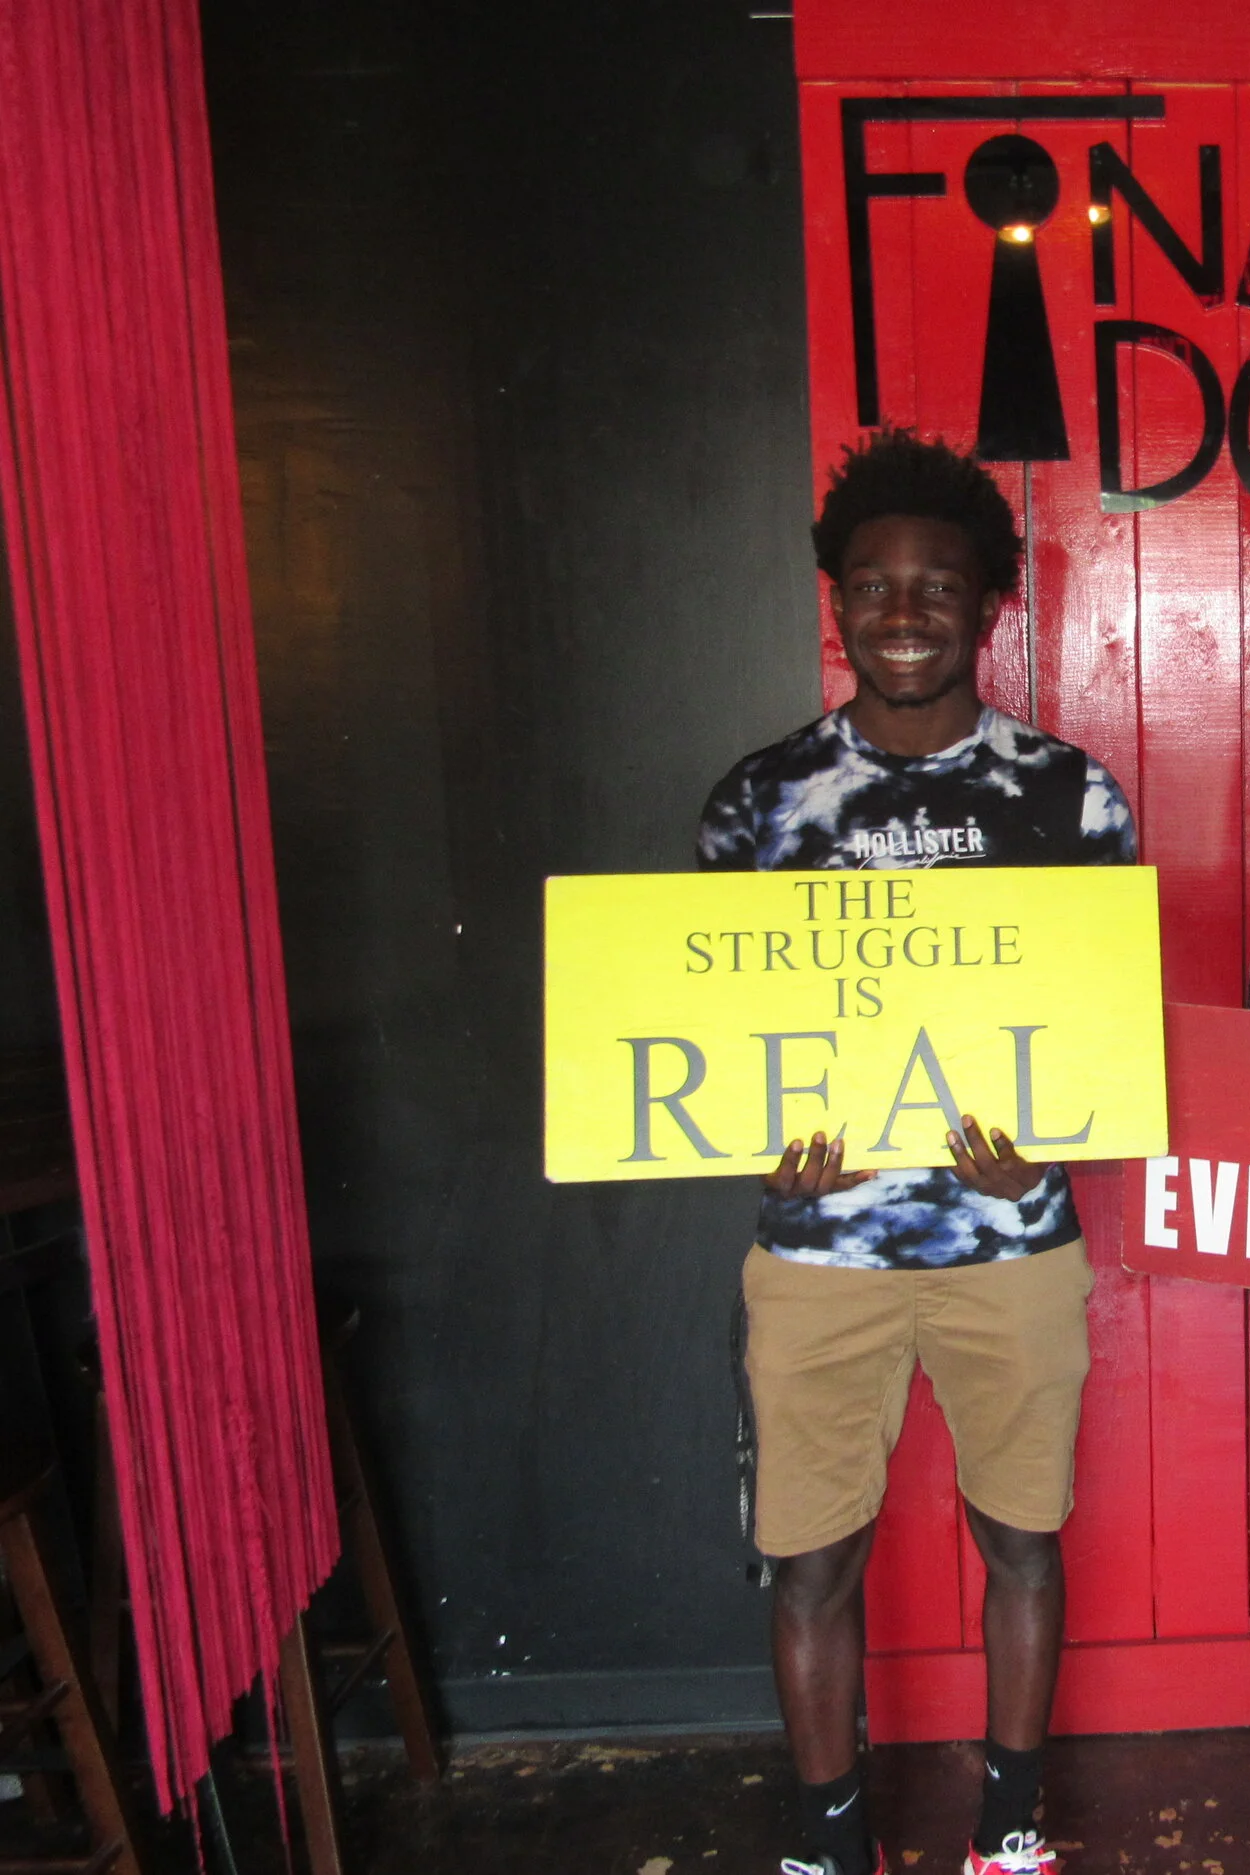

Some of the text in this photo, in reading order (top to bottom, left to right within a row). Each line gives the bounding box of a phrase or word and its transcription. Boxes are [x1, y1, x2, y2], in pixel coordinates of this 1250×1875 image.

[855, 827, 984, 859] HOLLISTER
[794, 879, 917, 921] THE
[686, 925, 1023, 973] STRUGGLE
[833, 976, 883, 1018] IS
[616, 1025, 1095, 1162] REAL
